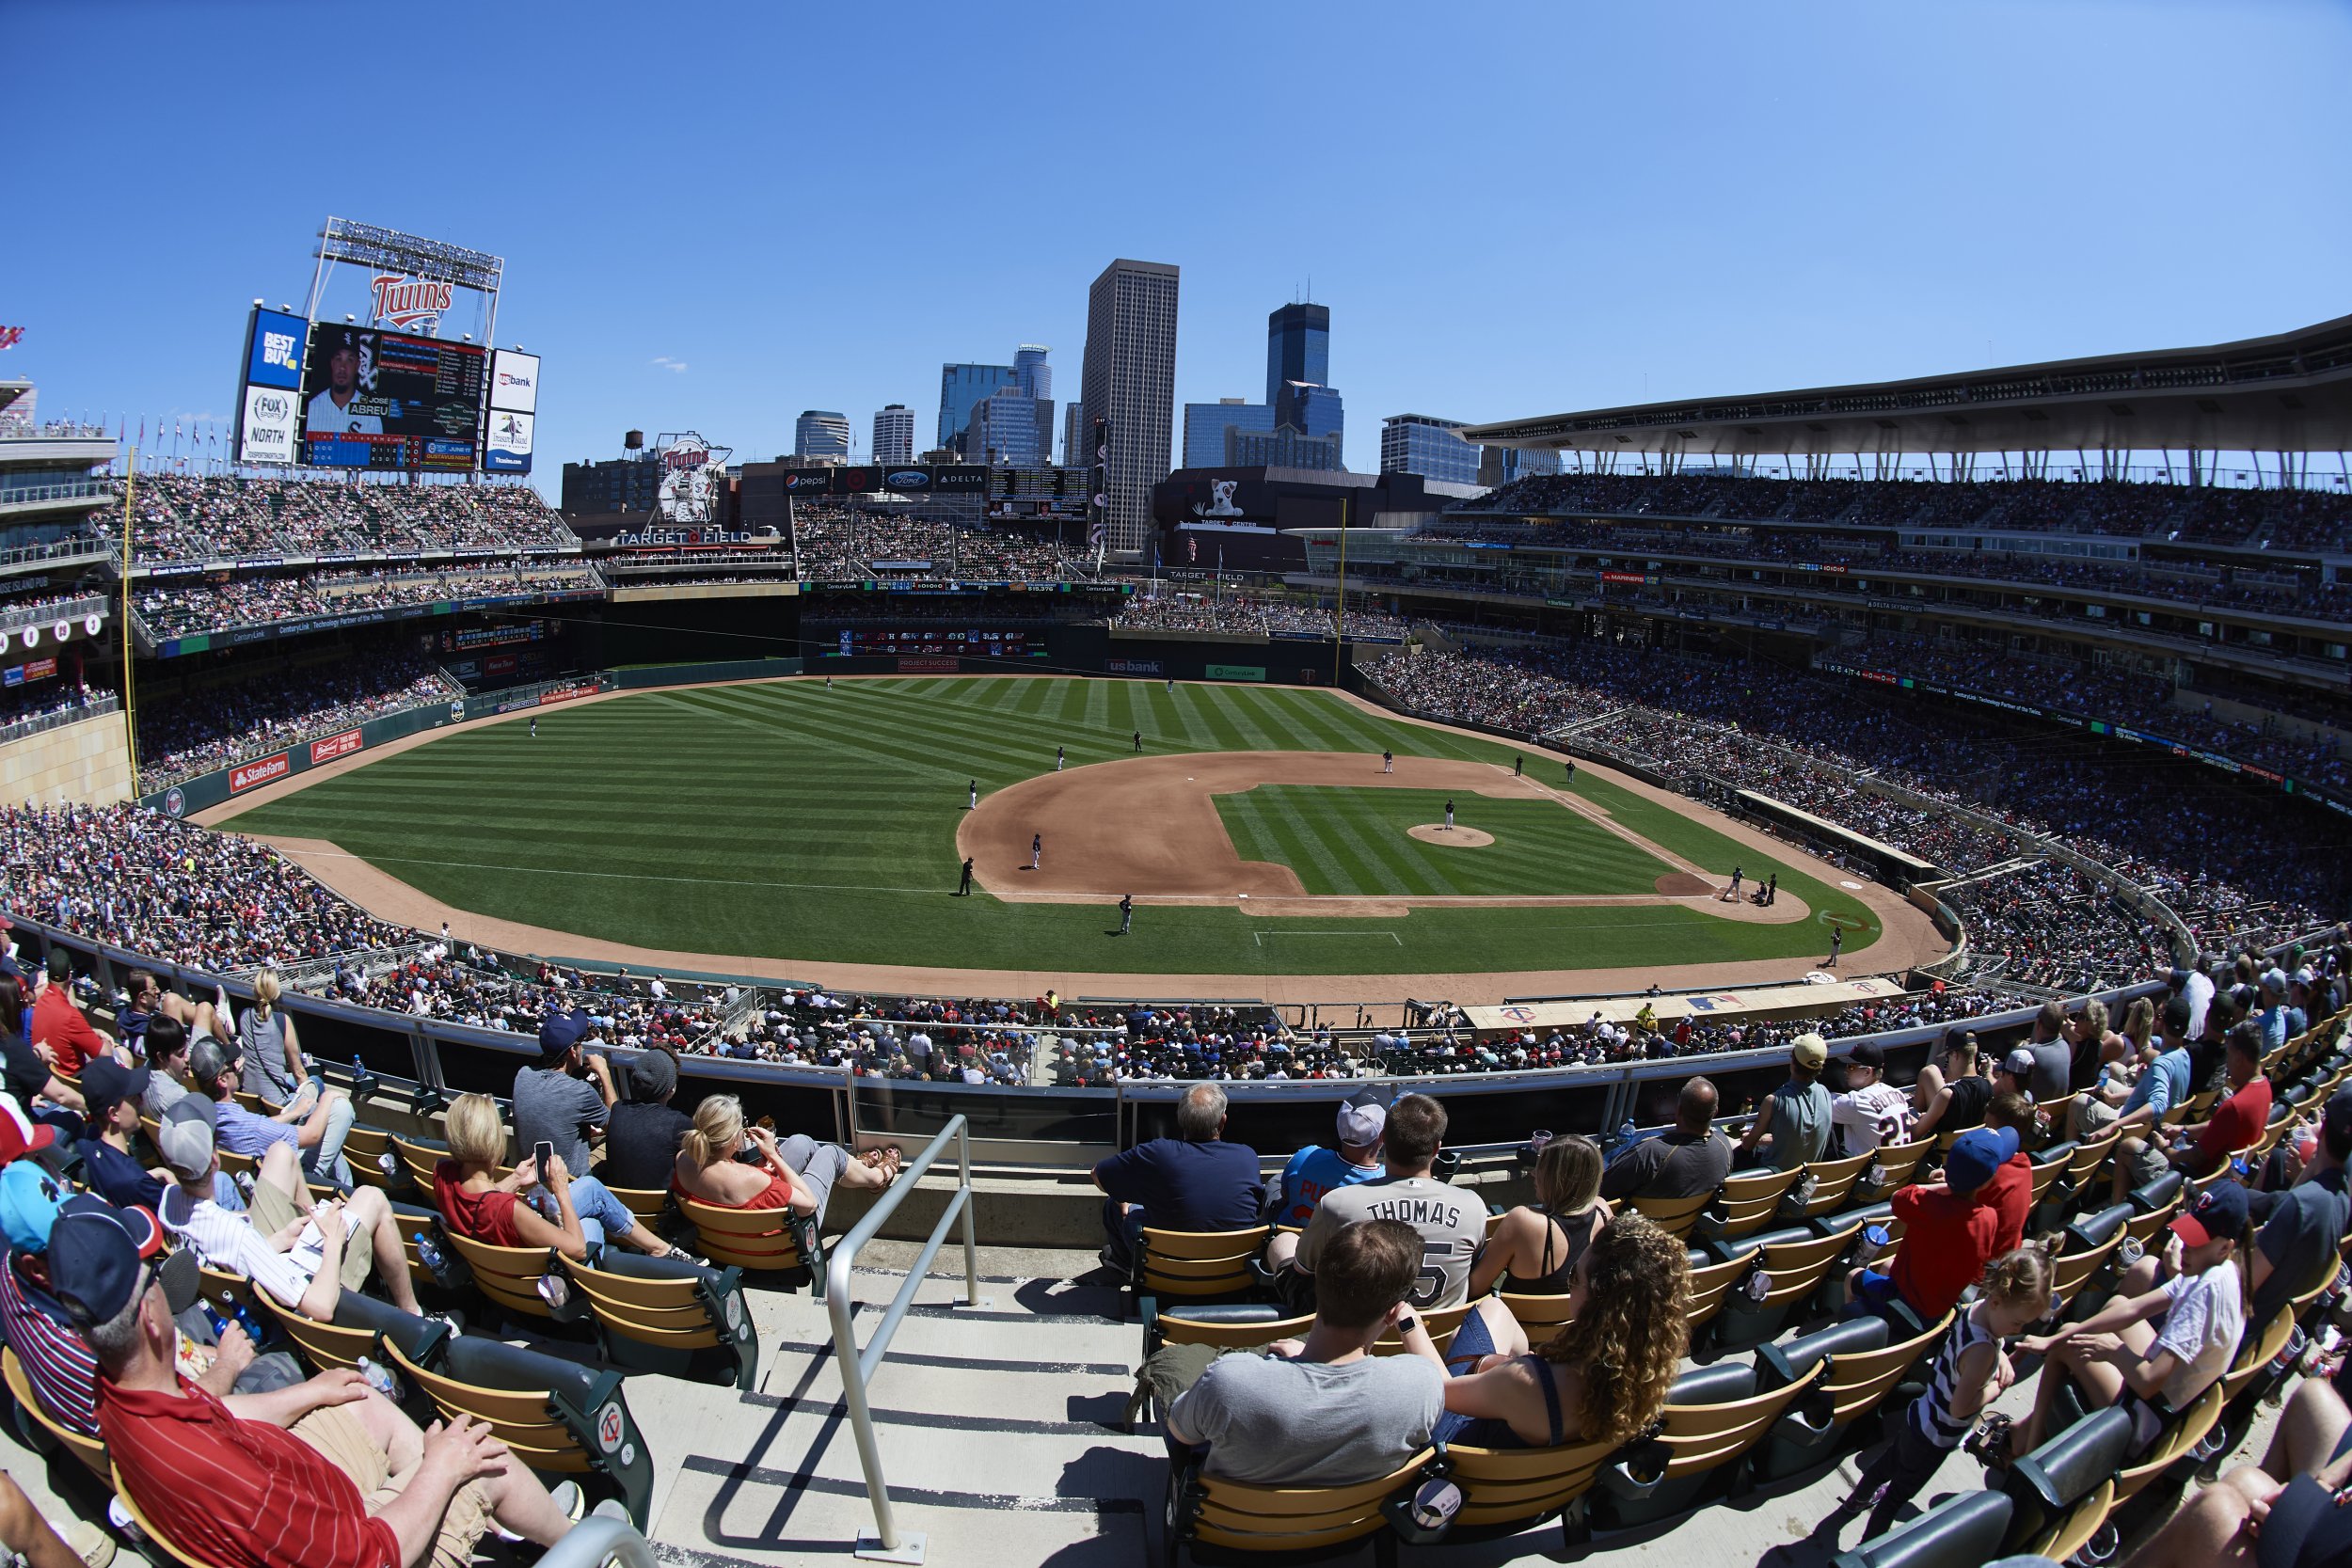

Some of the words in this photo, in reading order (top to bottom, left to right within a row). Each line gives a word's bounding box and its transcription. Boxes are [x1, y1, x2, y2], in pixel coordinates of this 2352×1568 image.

[372, 272, 453, 321] Twins
[264, 332, 296, 352] BEST
[264, 347, 291, 365] BUY
[261, 397, 281, 412] FOX
[350, 405, 388, 415] ABREU
[251, 426, 285, 443] NORTH
[663, 448, 709, 474] Twins
[800, 476, 826, 487] pepsi
[895, 473, 920, 484] Ford
[617, 533, 686, 544] TARGET
[704, 532, 752, 543] FIELD
[12, 578, 34, 590] ISLAND
[35, 576, 48, 587] PUB
[279, 622, 310, 634] CenturyLink
[313, 619, 339, 630] Technology
[340, 616, 357, 625] Partner
[235, 630, 265, 642] CenturyLink
[1926, 685, 1947, 694] CenturyLink
[1954, 691, 1976, 700] CenturyLink
[1979, 696, 2001, 707] Technology
[2000, 701, 2016, 710] Partner
[2057, 715, 2082, 726] CenturyLink
[1878, 1112, 1910, 1147] 25
[1366, 1198, 1461, 1230] THOMAS
